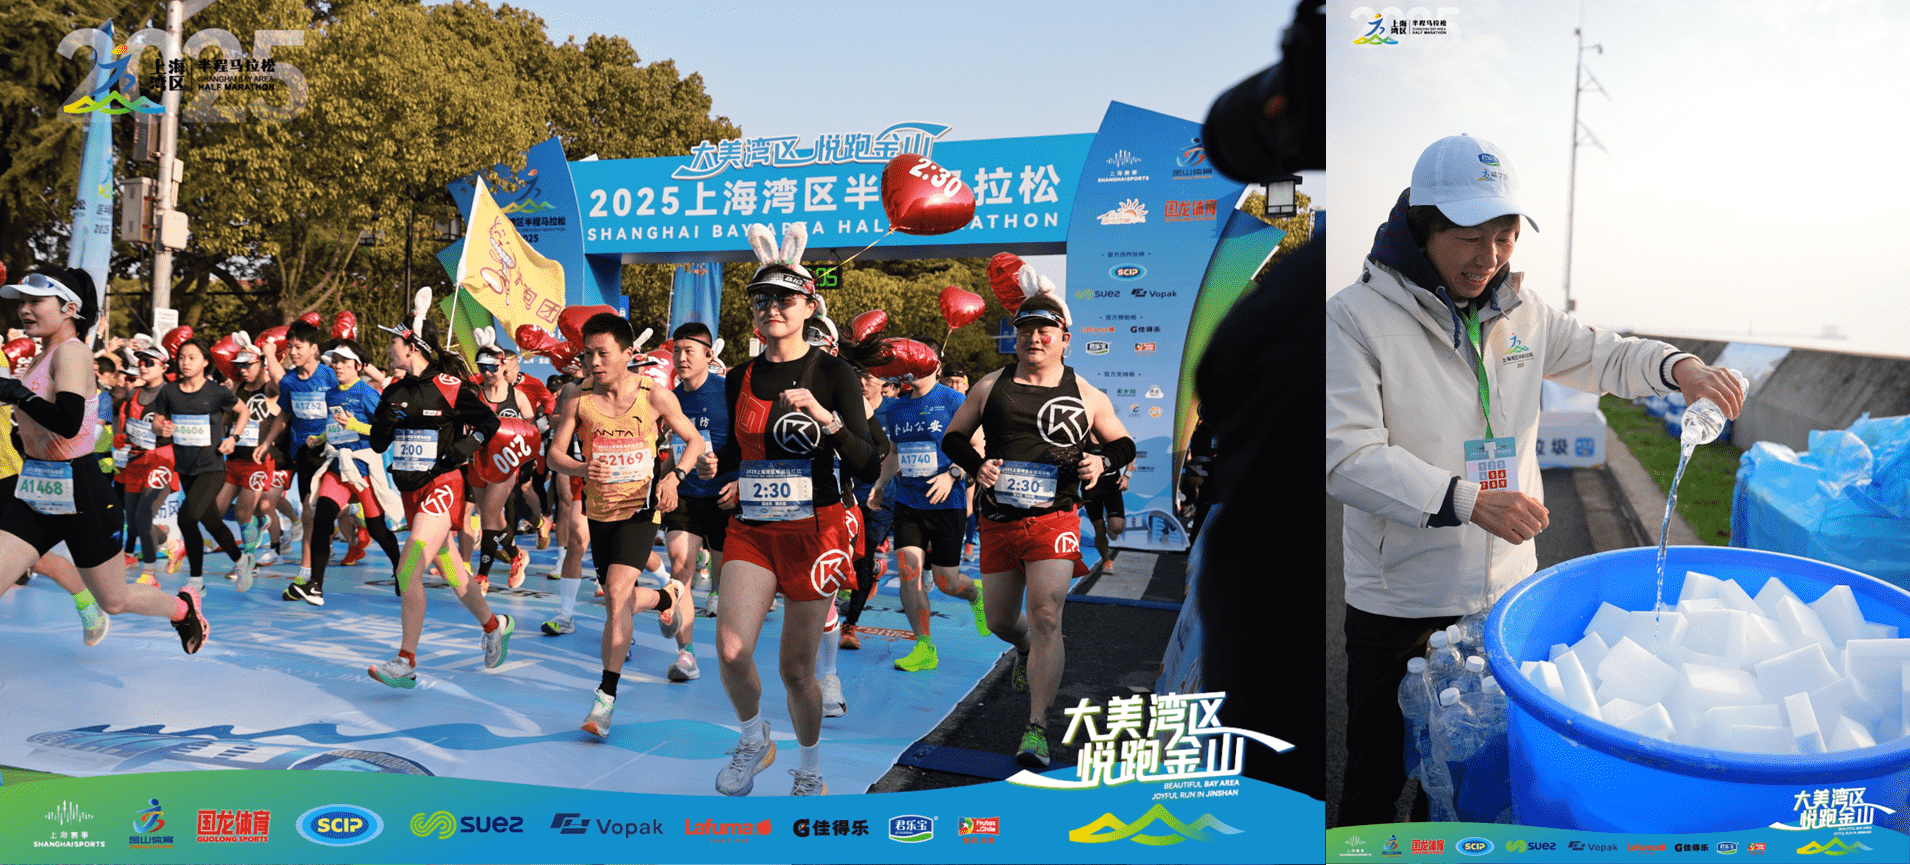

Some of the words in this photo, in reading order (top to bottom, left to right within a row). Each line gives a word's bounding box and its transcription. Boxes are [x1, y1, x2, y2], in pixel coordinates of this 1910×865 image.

[909, 157, 962, 198] 2:30
[589, 164, 1061, 217] 2025上海湾区半拉松
[1164, 199, 1218, 217] 国龙体育
[587, 225, 699, 242] SHANGHAI
[838, 219, 884, 234] HAL
[1117, 268, 1138, 276] SCIP
[1150, 290, 1177, 298] Vopak
[594, 429, 634, 438] ANTA
[401, 444, 422, 456] 2:00
[901, 454, 930, 464] A1740
[20, 479, 62, 496] A1468
[753, 482, 791, 498] 2:30
[1007, 478, 1040, 493] 2:30
